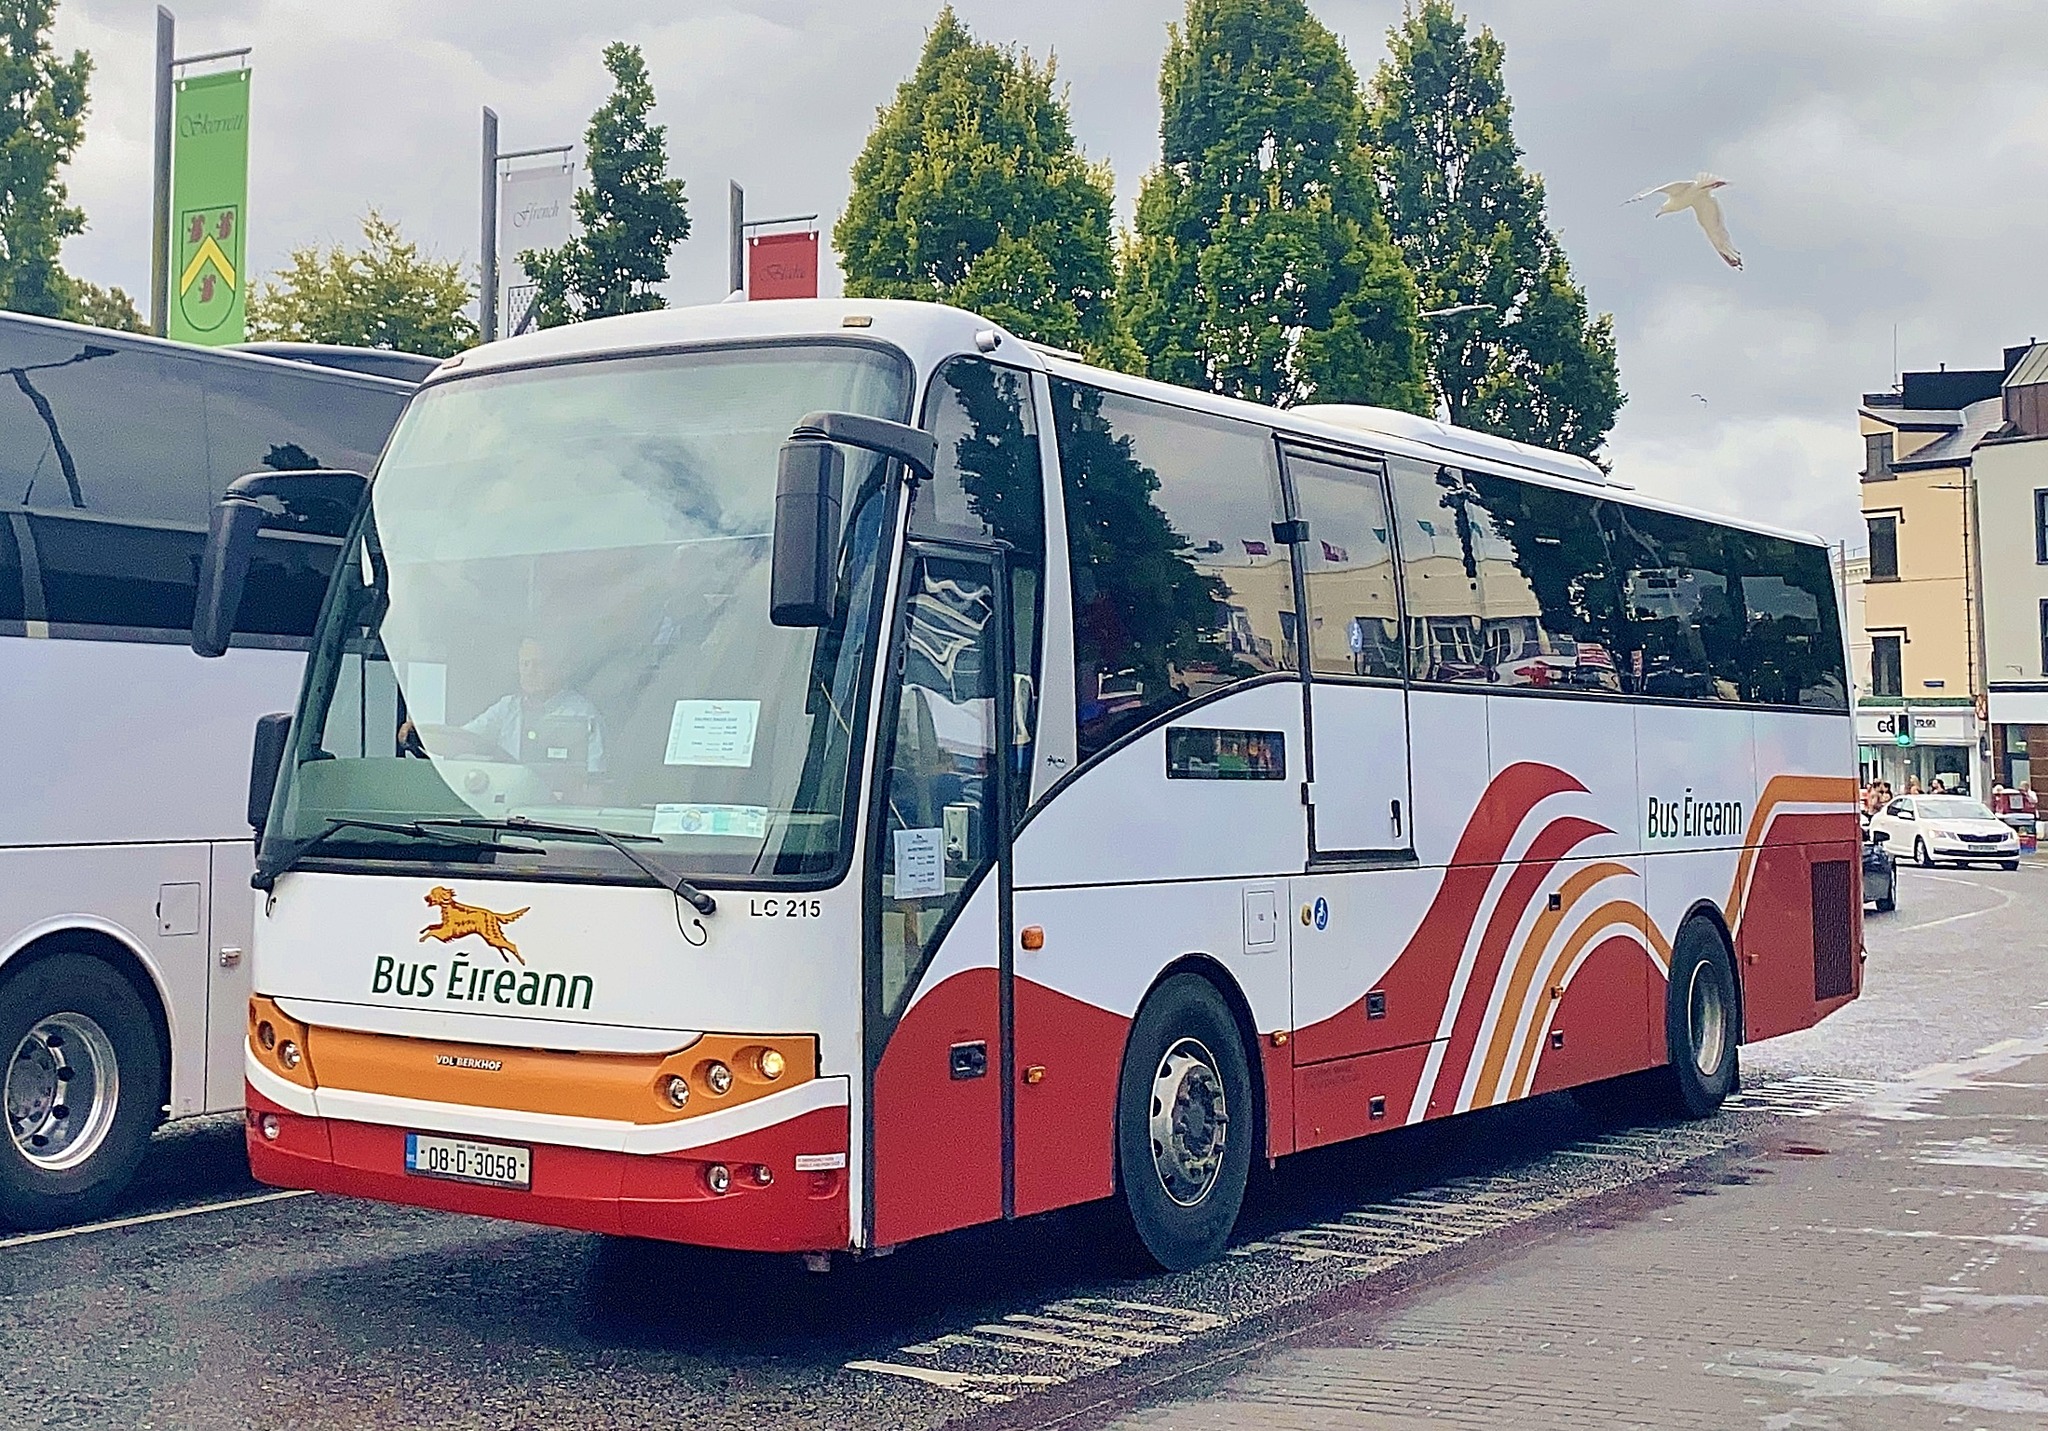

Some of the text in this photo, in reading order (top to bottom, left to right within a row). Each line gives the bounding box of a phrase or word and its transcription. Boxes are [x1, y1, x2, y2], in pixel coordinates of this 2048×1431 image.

[1648, 787, 1742, 838] Bus Éireann
[750, 899, 821, 918] LC 215
[371, 952, 595, 1010] Bus Éireann
[435, 1055, 503, 1071] VDL BERKHOF
[428, 1146, 518, 1180] 08-D-3058
